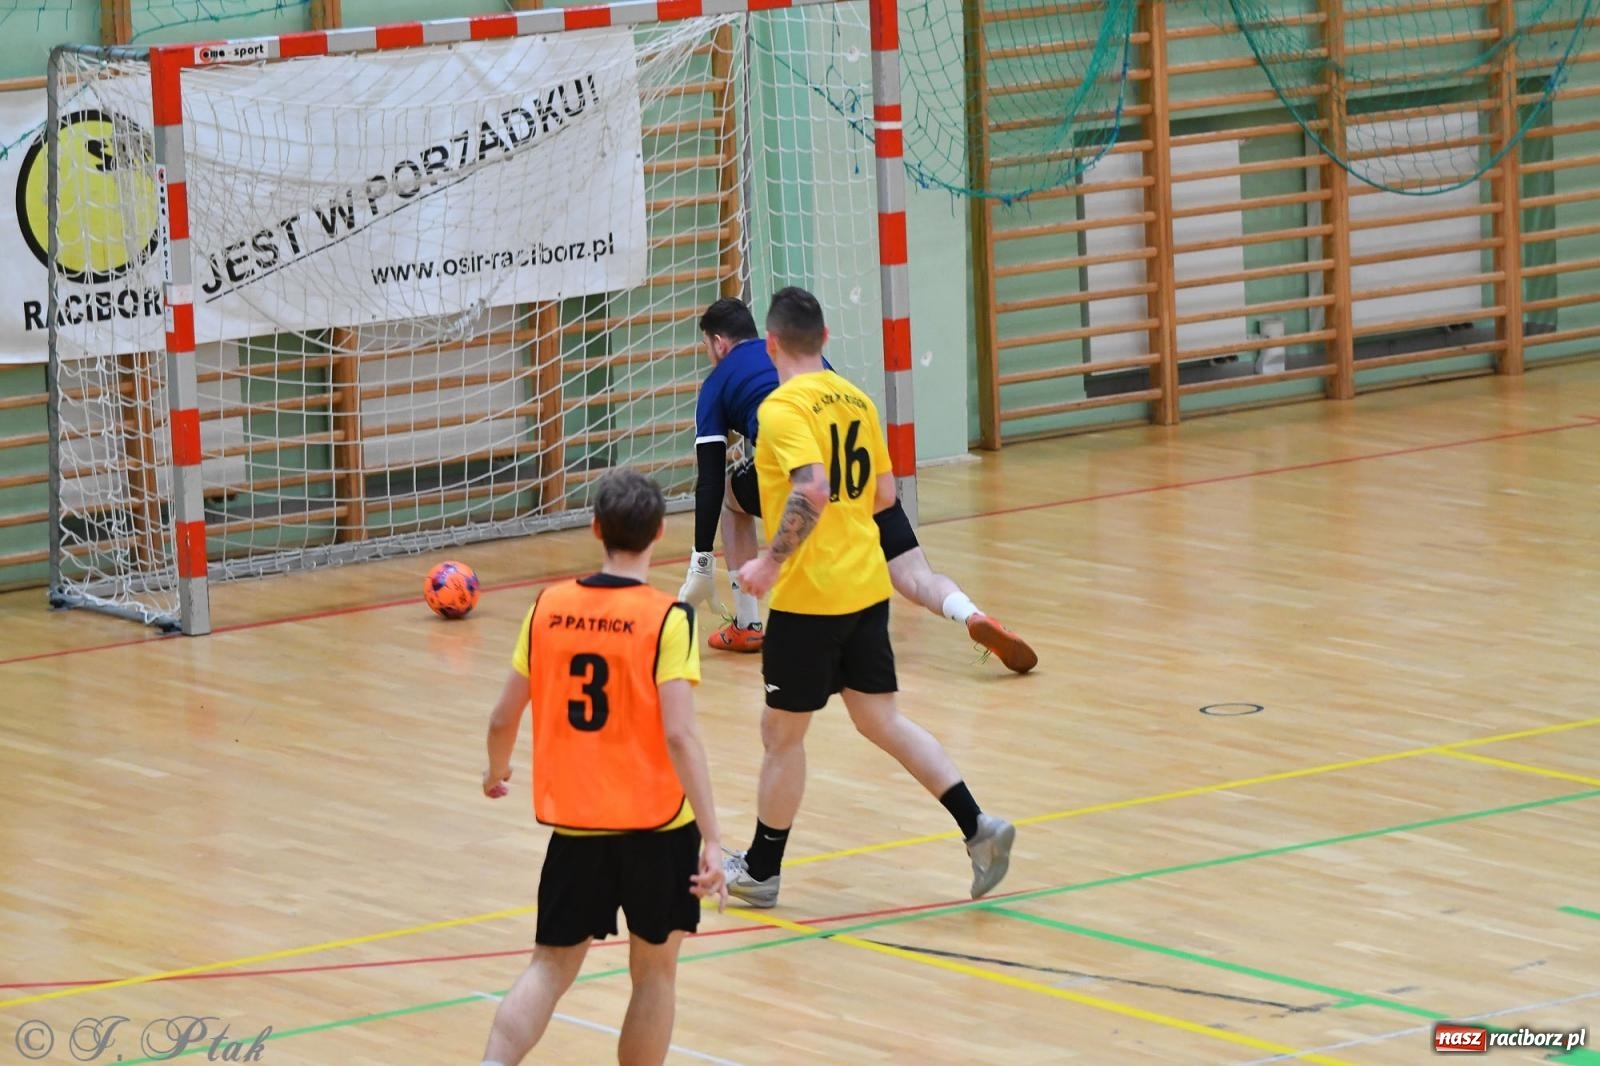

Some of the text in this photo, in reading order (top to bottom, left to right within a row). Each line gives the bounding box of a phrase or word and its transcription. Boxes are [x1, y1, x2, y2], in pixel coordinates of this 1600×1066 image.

[234, 44, 264, 58] sport
[202, 214, 301, 294] JEST
[313, 189, 356, 238] W
[371, 232, 615, 285] www.osir-raciborz.pl
[829, 420, 871, 503] 16
[565, 615, 635, 634] PATRICK
[568, 653, 610, 732] 3
